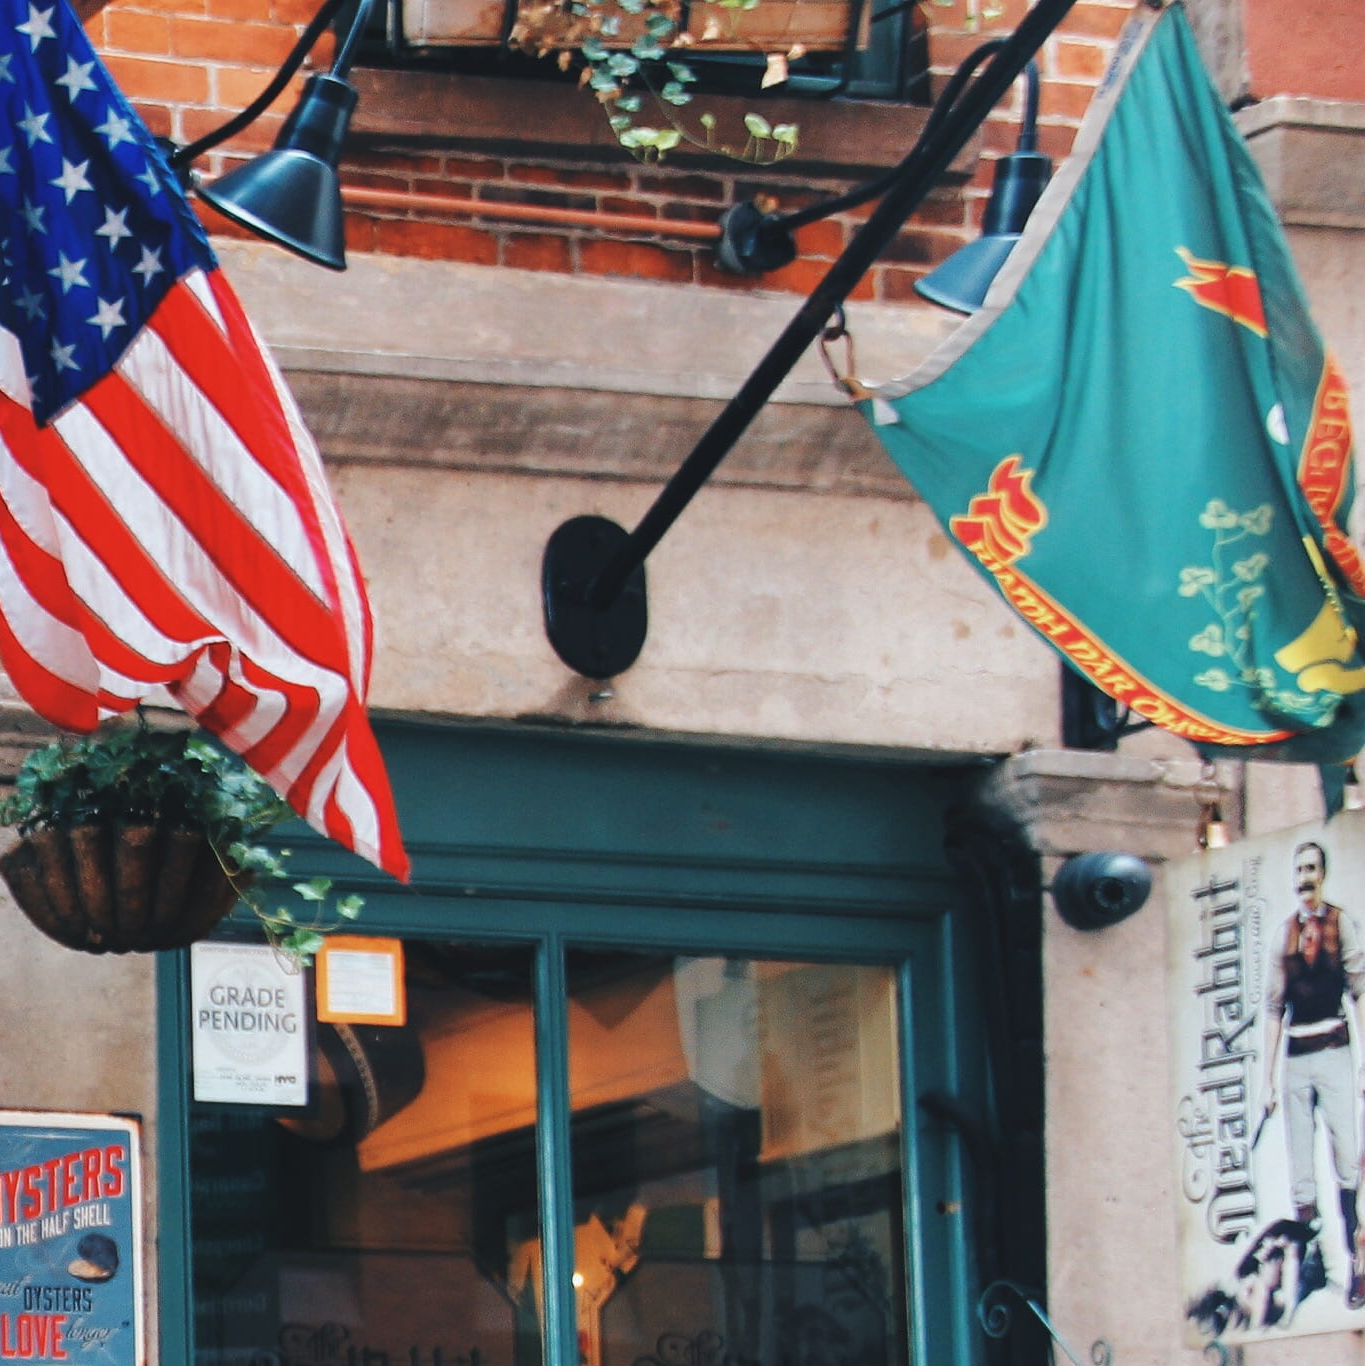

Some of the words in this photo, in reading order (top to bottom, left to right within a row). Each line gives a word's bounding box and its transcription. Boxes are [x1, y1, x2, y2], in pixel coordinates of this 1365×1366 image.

[1191, 874, 1258, 1071] Rabbit
[209, 986, 285, 1009] GRADE
[198, 1009, 297, 1034] PENDING
[1199, 1073, 1257, 1244] Dead
[16, 1222, 38, 1245] THE
[41, 1211, 70, 1240] HALF
[73, 1204, 112, 1231] SHELL
[23, 1286, 93, 1313] OYSTERS
[0, 1312, 68, 1360] LOVE
